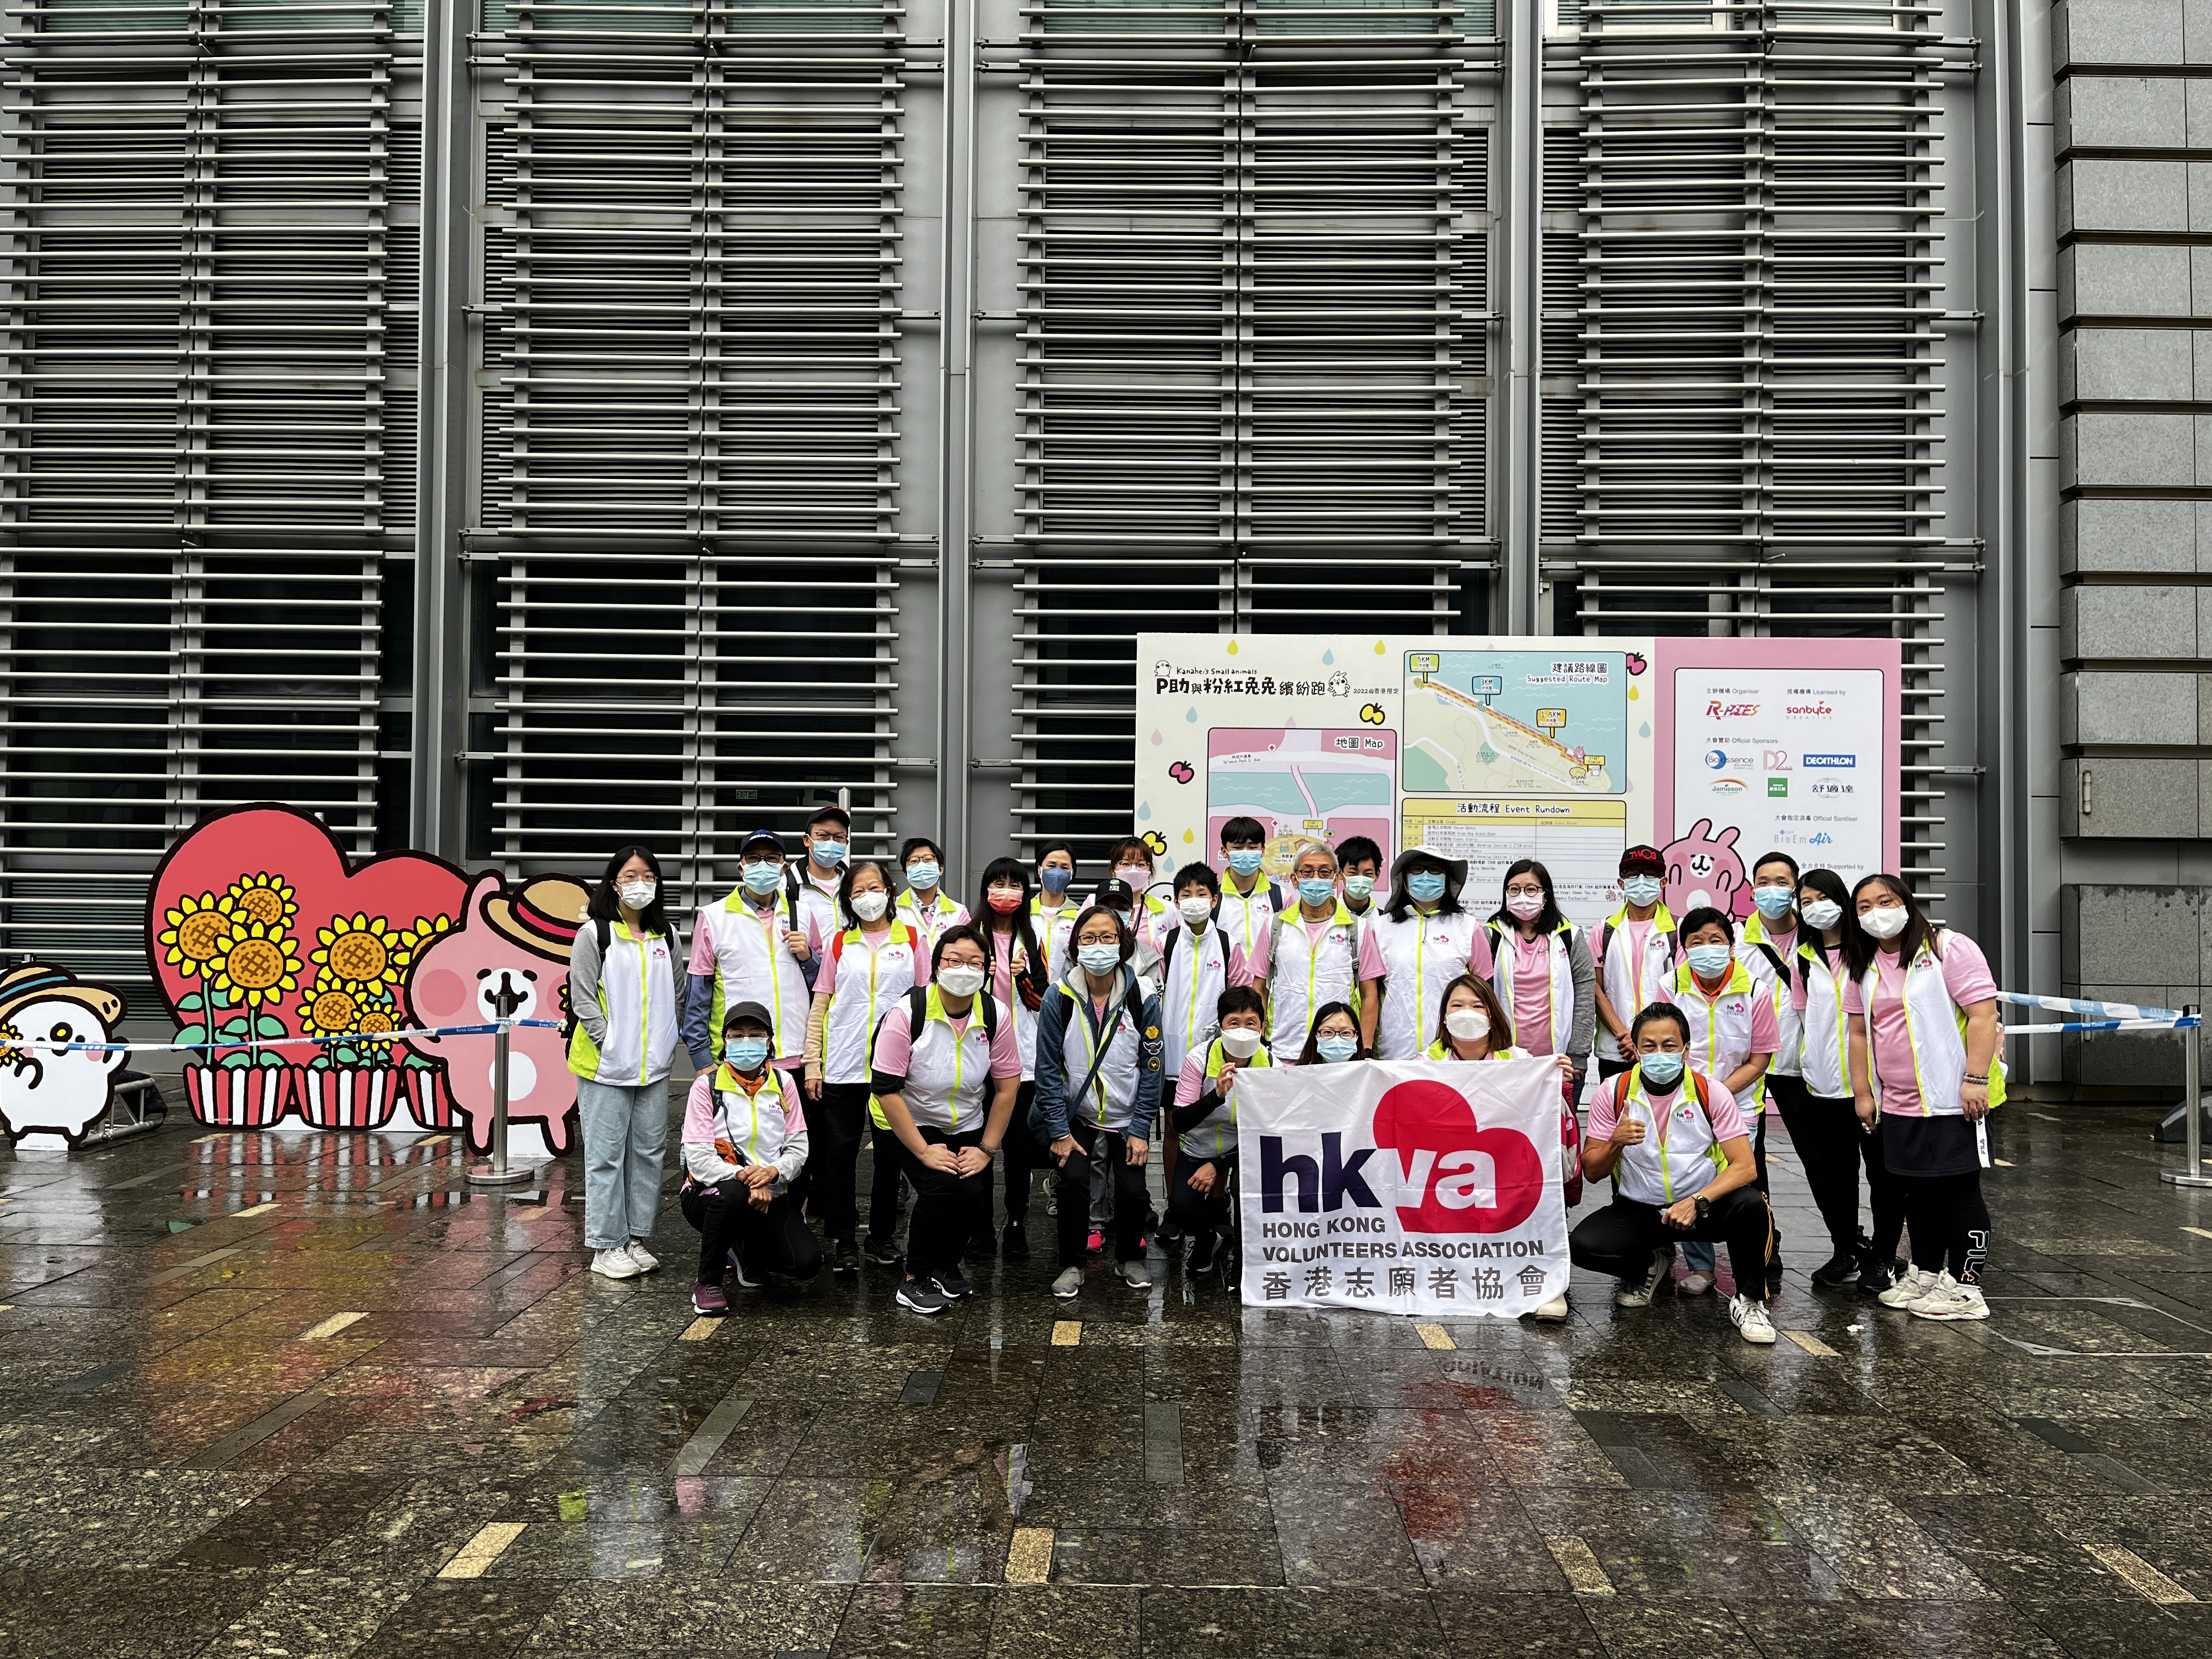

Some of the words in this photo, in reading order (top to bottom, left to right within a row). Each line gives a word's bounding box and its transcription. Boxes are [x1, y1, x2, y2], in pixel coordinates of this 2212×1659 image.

[1177, 666, 1209, 675] Kanahei's
[1552, 663, 1607, 673] 建議路線圖
[1786, 704, 1832, 715] sanbyte
[1336, 737, 1359, 748] 地圖
[1365, 738, 1384, 749] Map
[1806, 757, 1853, 765] DECATHLON
[1457, 803, 1500, 813] 活動流程
[1506, 804, 1531, 813] Event
[1535, 804, 1570, 814] Rundown
[1809, 832, 1833, 845] Air
[1260, 1131, 1498, 1214] hkva
[1262, 1221, 1320, 1238] HONG
[1327, 1217, 1386, 1235] KONG
[1262, 1242, 1397, 1263] VOLUNTEERS
[1402, 1240, 1544, 1259] ASSOCIATION
[1961, 1230, 1990, 1284] FILA
[1262, 1265, 1548, 1301] 香港志願者協會
